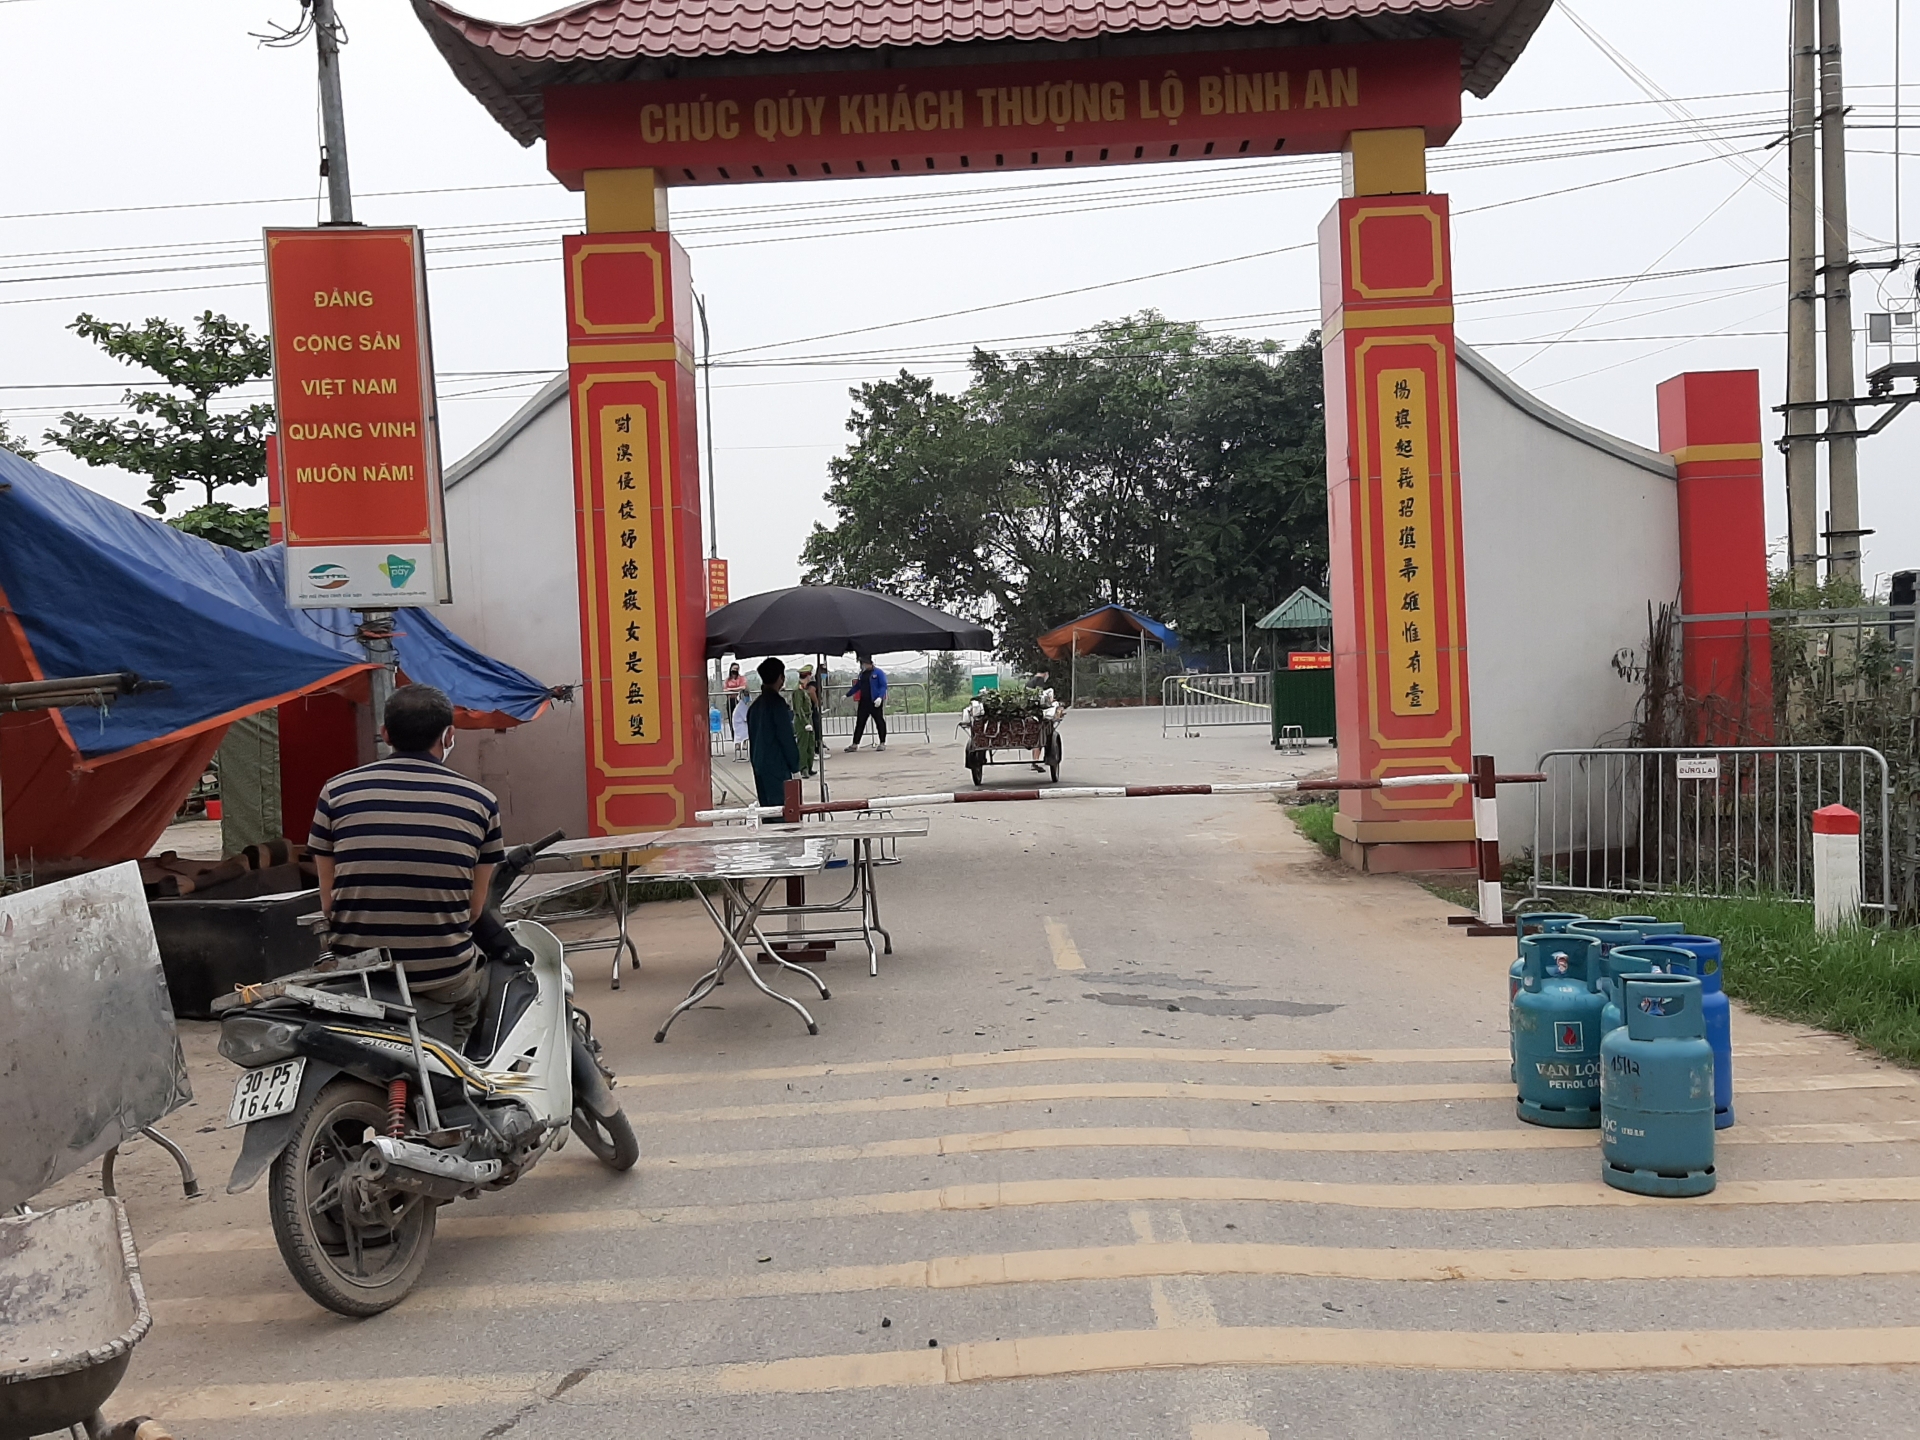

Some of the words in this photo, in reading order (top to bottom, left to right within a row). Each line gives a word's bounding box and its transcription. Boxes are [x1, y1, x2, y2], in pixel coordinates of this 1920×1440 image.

[640, 93, 740, 144] CHÚC
[754, 89, 826, 143] QÚY
[839, 84, 965, 135] KHÁCH
[977, 79, 1126, 132] THƯỢNG
[1139, 69, 1185, 126] LỘ
[1200, 66, 1289, 116] BÌNH
[1304, 67, 1359, 110] AN
[314, 287, 373, 307] ĐẢNG
[293, 334, 353, 355] CỘNG
[359, 331, 400, 351] SẢN
[301, 378, 346, 400] VIỆT
[353, 378, 397, 395] NAM
[288, 423, 363, 441] QUANG
[369, 422, 416, 439] VINH
[296, 463, 357, 483] MUÔN
[363, 462, 414, 482] NĂM!
[241, 1063, 293, 1095] 30-P5
[1549, 1080, 1586, 1090] PETROL
[239, 1087, 285, 1120] 1644
